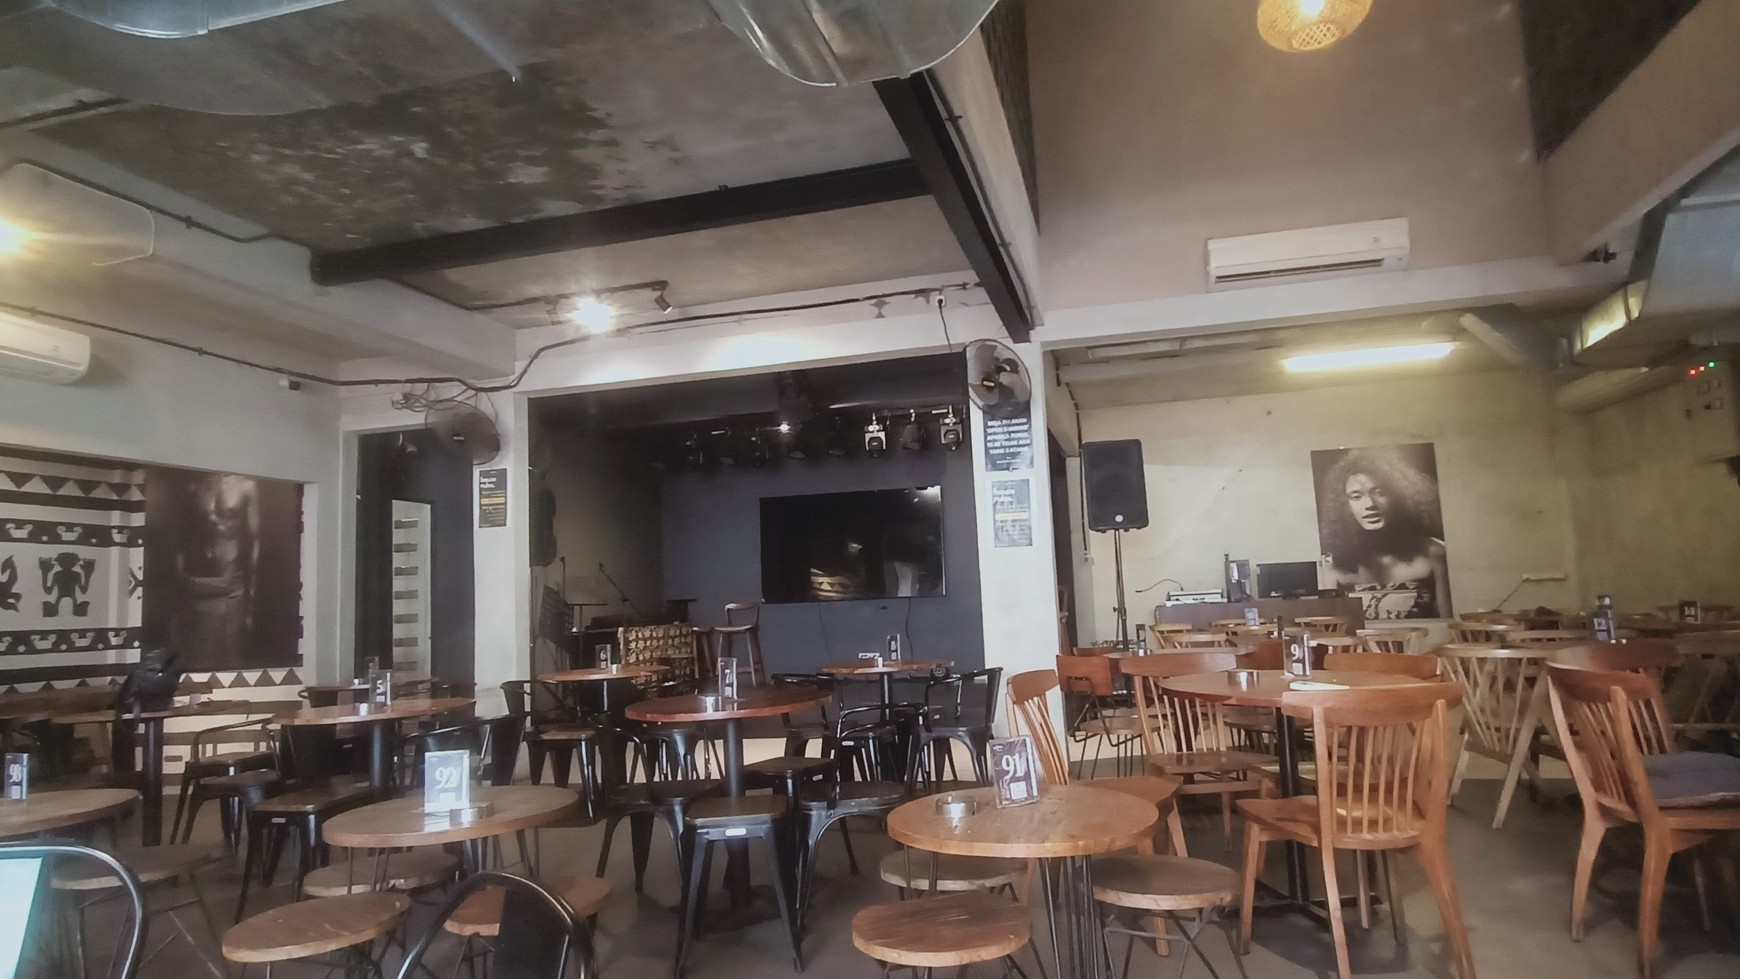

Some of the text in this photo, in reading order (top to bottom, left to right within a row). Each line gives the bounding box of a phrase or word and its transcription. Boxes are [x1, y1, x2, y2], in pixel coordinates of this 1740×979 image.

[600, 650, 606, 660] 6
[1290, 643, 1300, 660] 9
[724, 669, 731, 684] 7
[376, 679, 384, 694] 5
[1001, 752, 1025, 780] 91
[434, 766, 459, 790] 92
